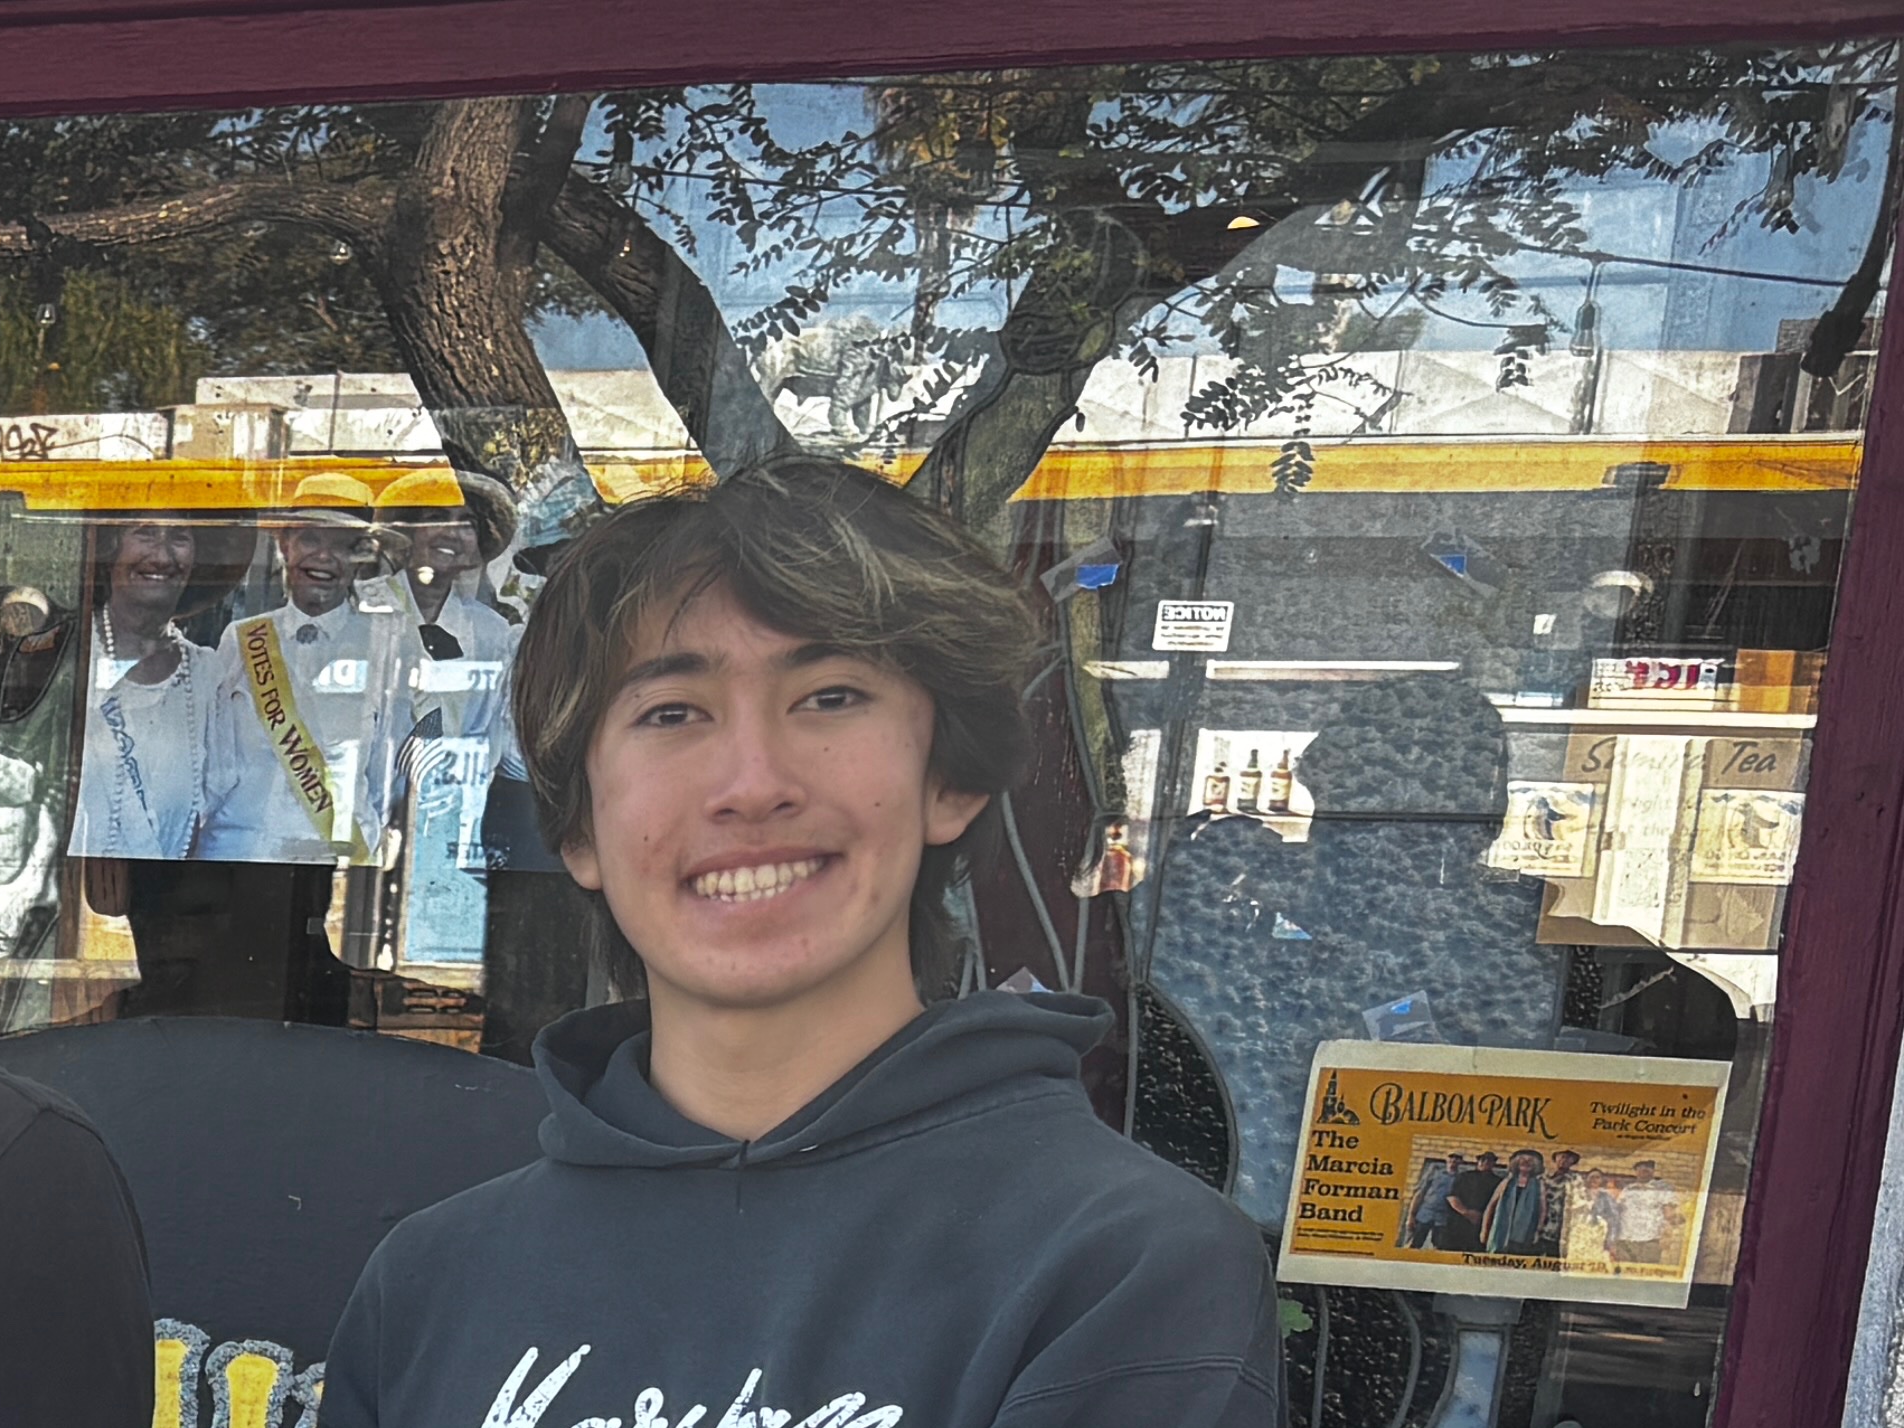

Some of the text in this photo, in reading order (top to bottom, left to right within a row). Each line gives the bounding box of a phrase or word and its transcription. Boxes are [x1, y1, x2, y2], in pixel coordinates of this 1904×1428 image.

[245, 622, 334, 814] VOTES FOR WOMEN
[1721, 740, 1777, 774] Tea
[1370, 1082, 1558, 1140] BALBOA PARK
[1589, 1100, 1658, 1118] Twilight
[1659, 1105, 1677, 1117] in
[1591, 1117, 1698, 1134] Park Concert
[1312, 1130, 1359, 1150] The
[1306, 1154, 1394, 1176] Marcia
[1303, 1178, 1400, 1200] Forman
[1299, 1203, 1363, 1223] Band
[1462, 1254, 1527, 1269] Tuesday,
[1532, 1258, 1585, 1272] August
